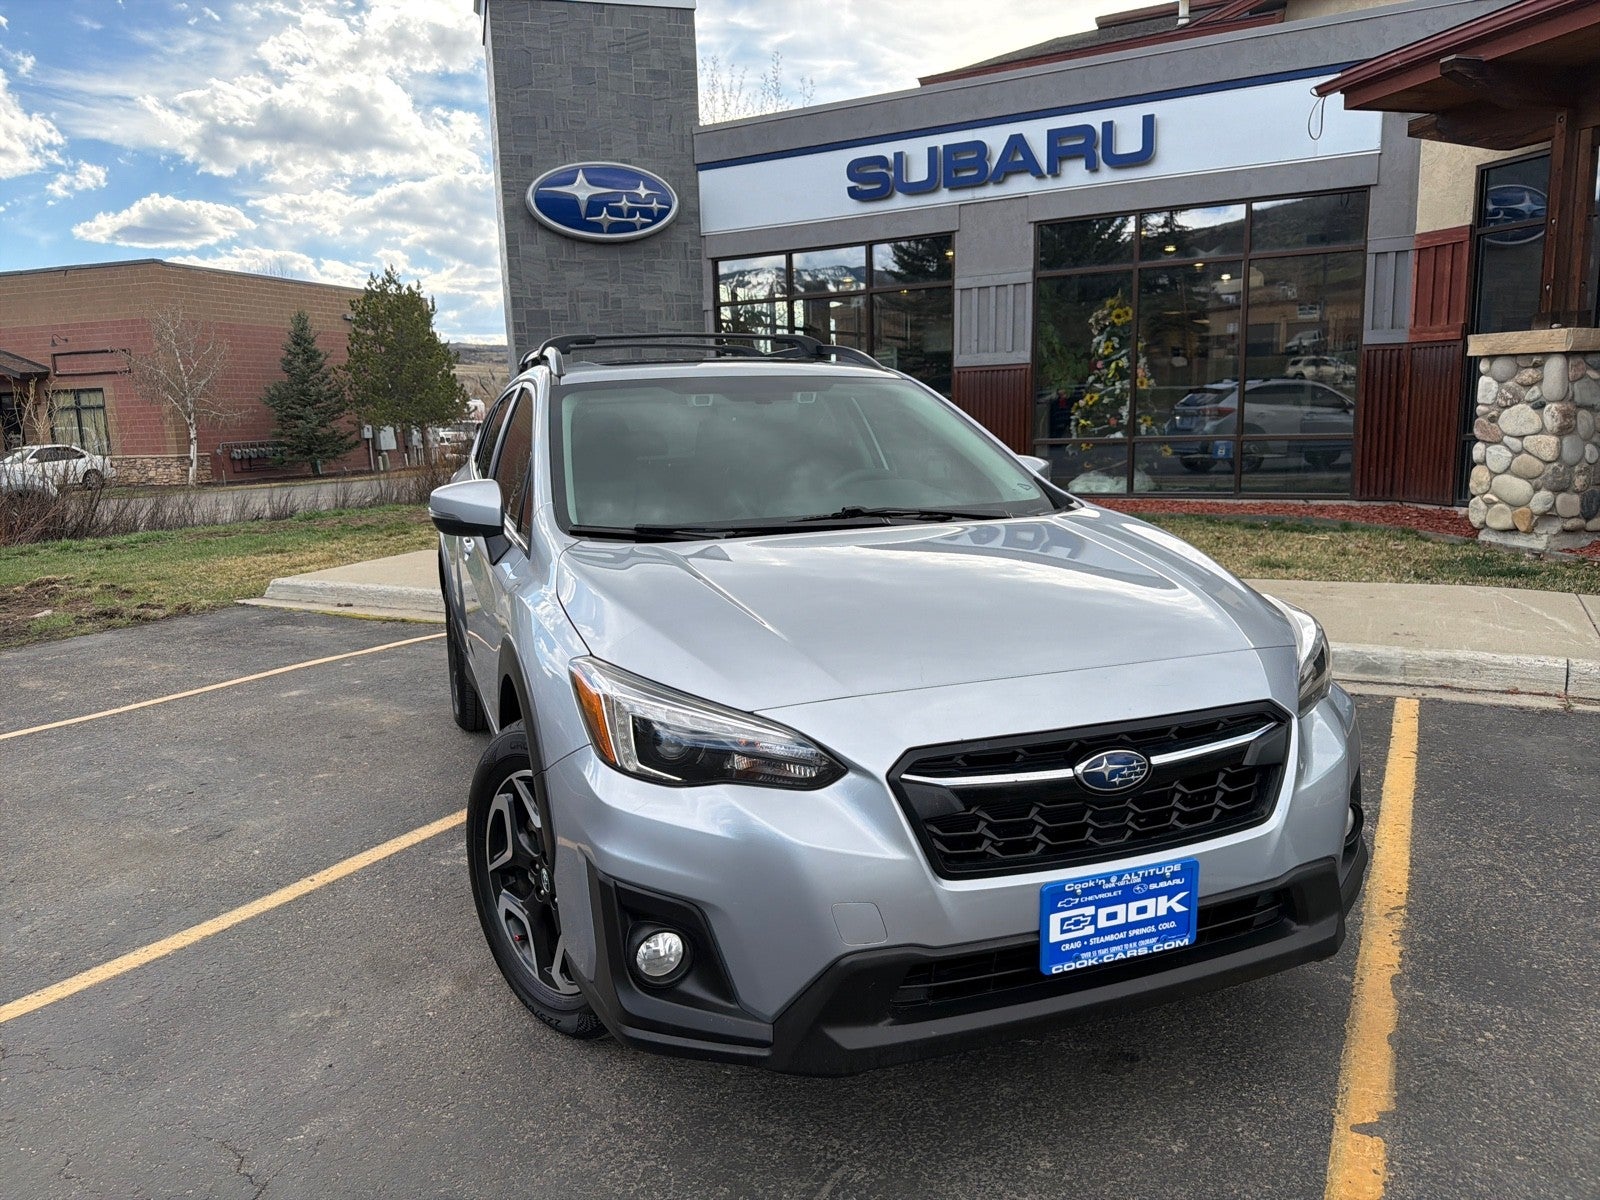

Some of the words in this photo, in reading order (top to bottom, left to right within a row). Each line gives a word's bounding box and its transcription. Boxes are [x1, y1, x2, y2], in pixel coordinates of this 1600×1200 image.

[847, 114, 1156, 201] SUBARU
[1064, 878, 1106, 892] Cook'n
[1121, 863, 1182, 881] ALTITUDE
[1149, 877, 1185, 890] SUBARU
[1080, 889, 1123, 903] CHEVROLET
[1049, 890, 1190, 943] COOK
[1061, 941, 1082, 952] CRAIG
[1089, 930, 1127, 946] STEAMBOAT
[1128, 924, 1157, 938] SPRINGS,
[1158, 920, 1177, 931] COLO.
